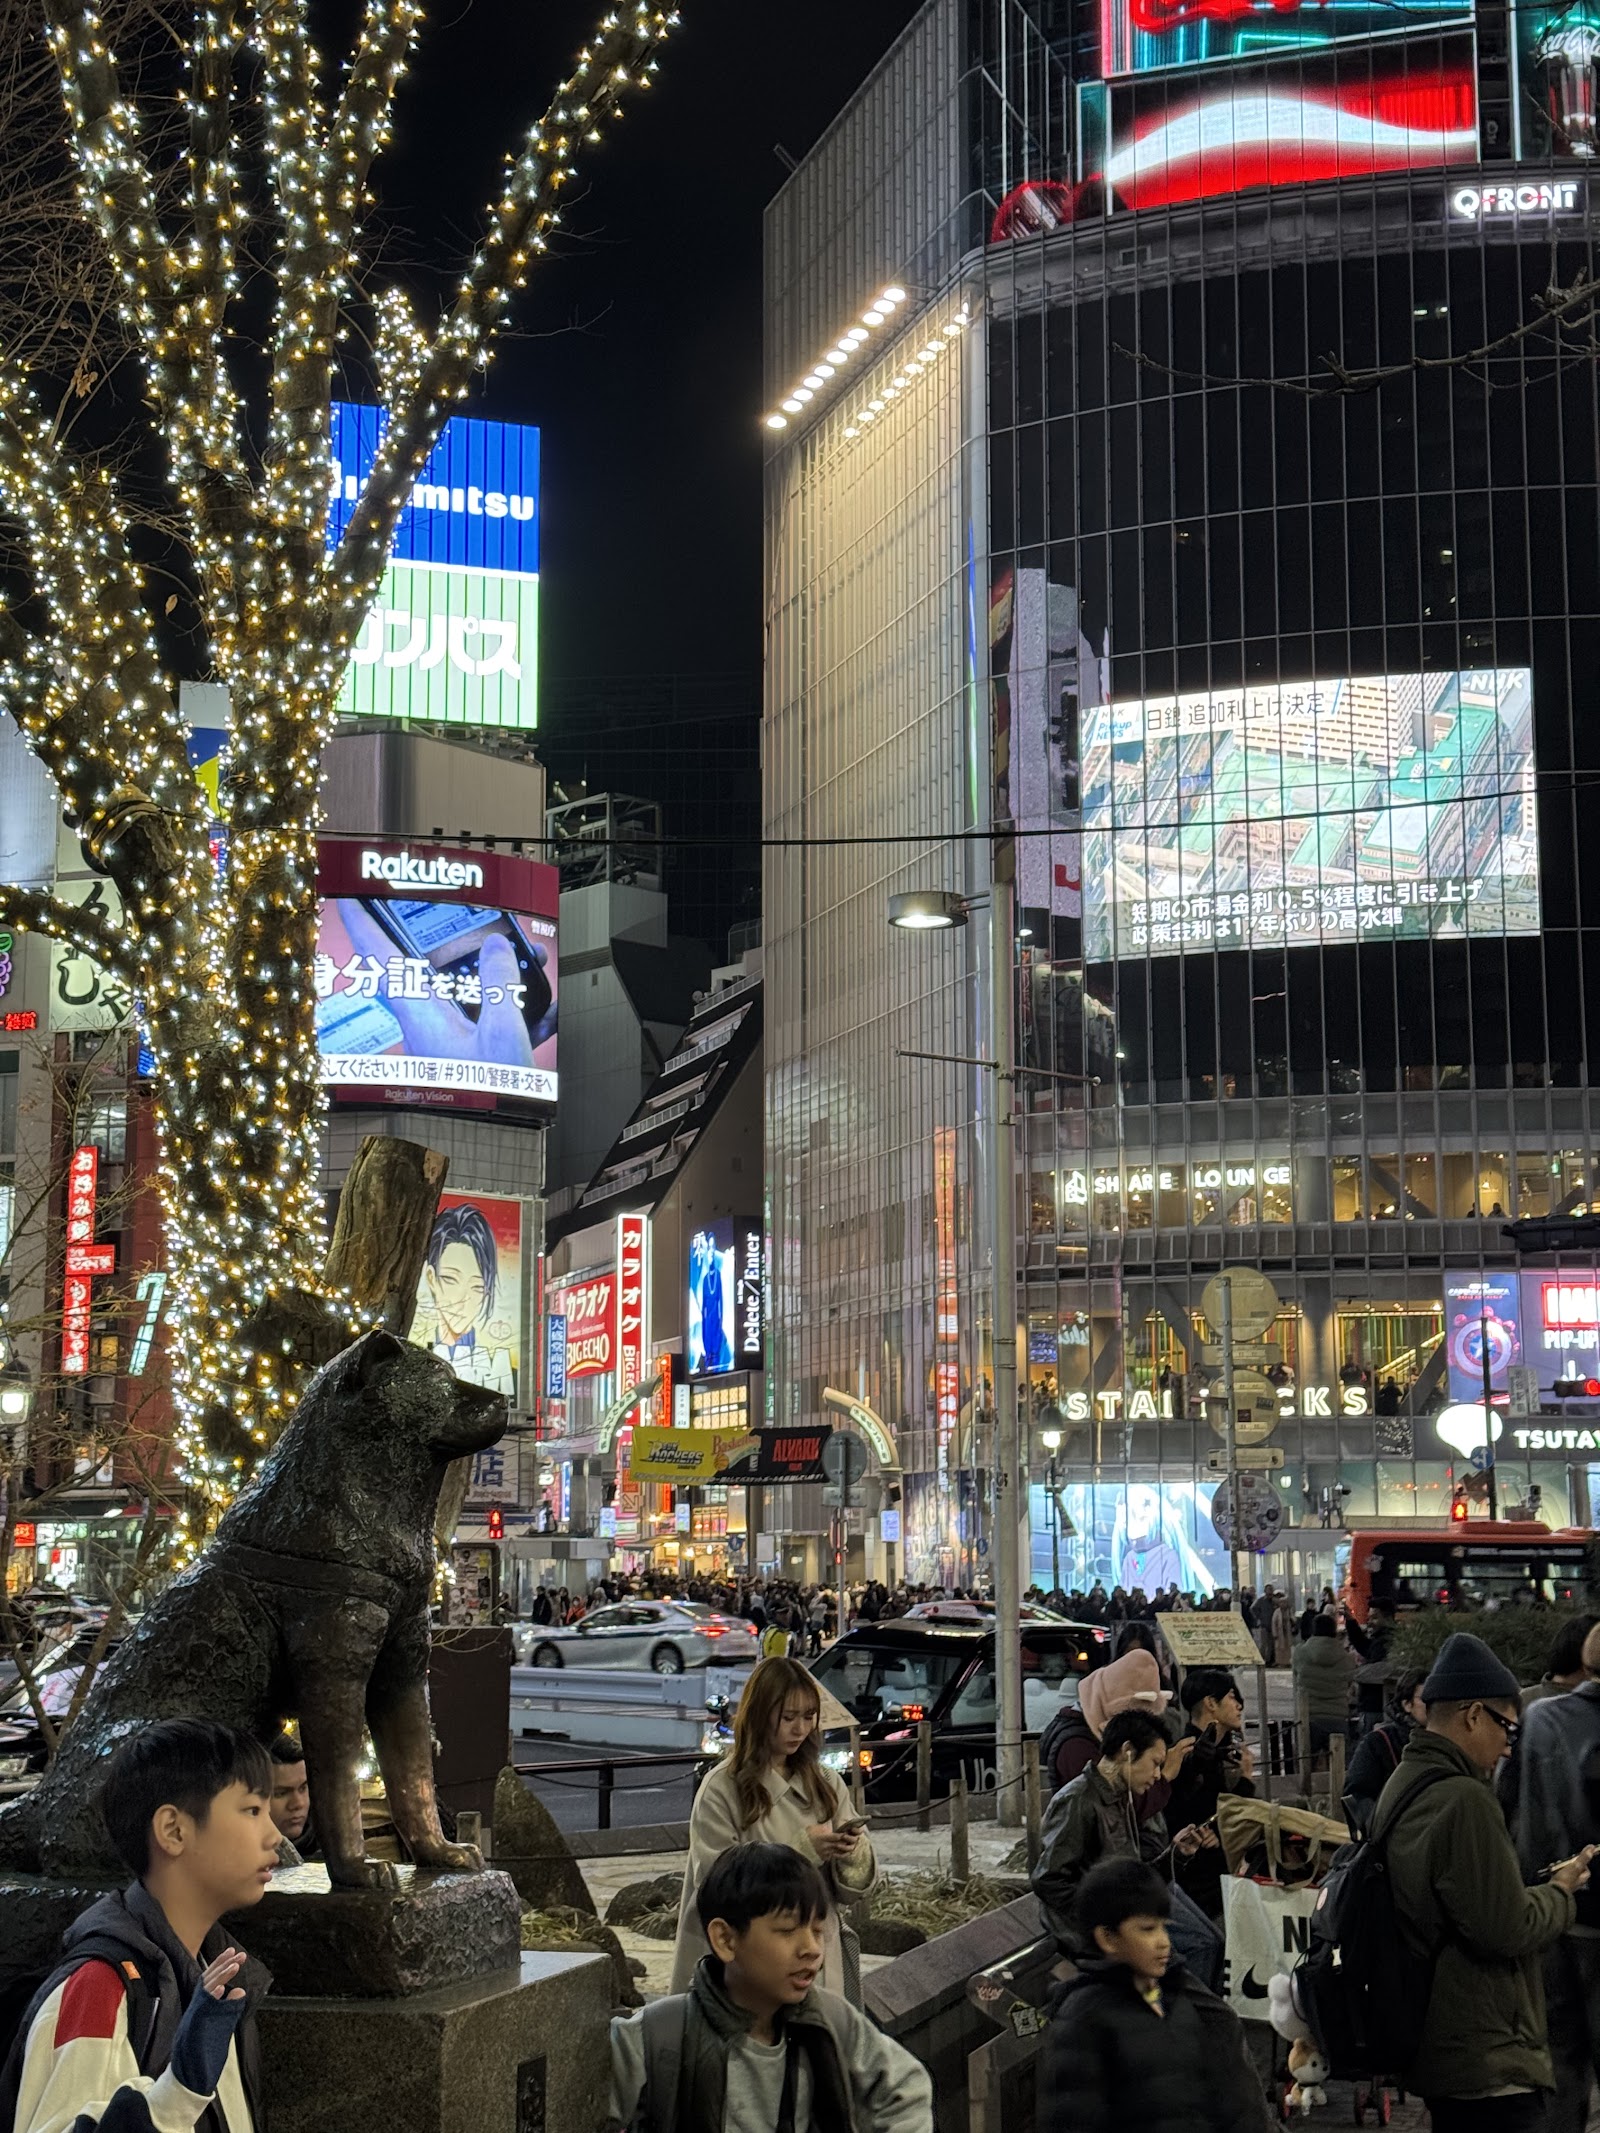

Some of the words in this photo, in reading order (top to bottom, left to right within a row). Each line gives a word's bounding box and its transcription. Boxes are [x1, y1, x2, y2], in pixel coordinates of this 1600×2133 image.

[1454, 184, 1578, 219] QFRONT
[1148, 708, 1181, 731] 日銀
[1188, 692, 1325, 727] 追加利上げ決定
[362, 851, 483, 889] Rakuten
[313, 953, 528, 1009] 身分証を送って
[1094, 1173, 1173, 1194] SHARE
[1194, 1167, 1291, 1188] LOUNGE
[622, 1230, 641, 1333] カラオケ
[566, 1282, 611, 1323] カラオケ
[772, 1437, 821, 1462] ALVARK
[1282, 1915, 1312, 1953] N
